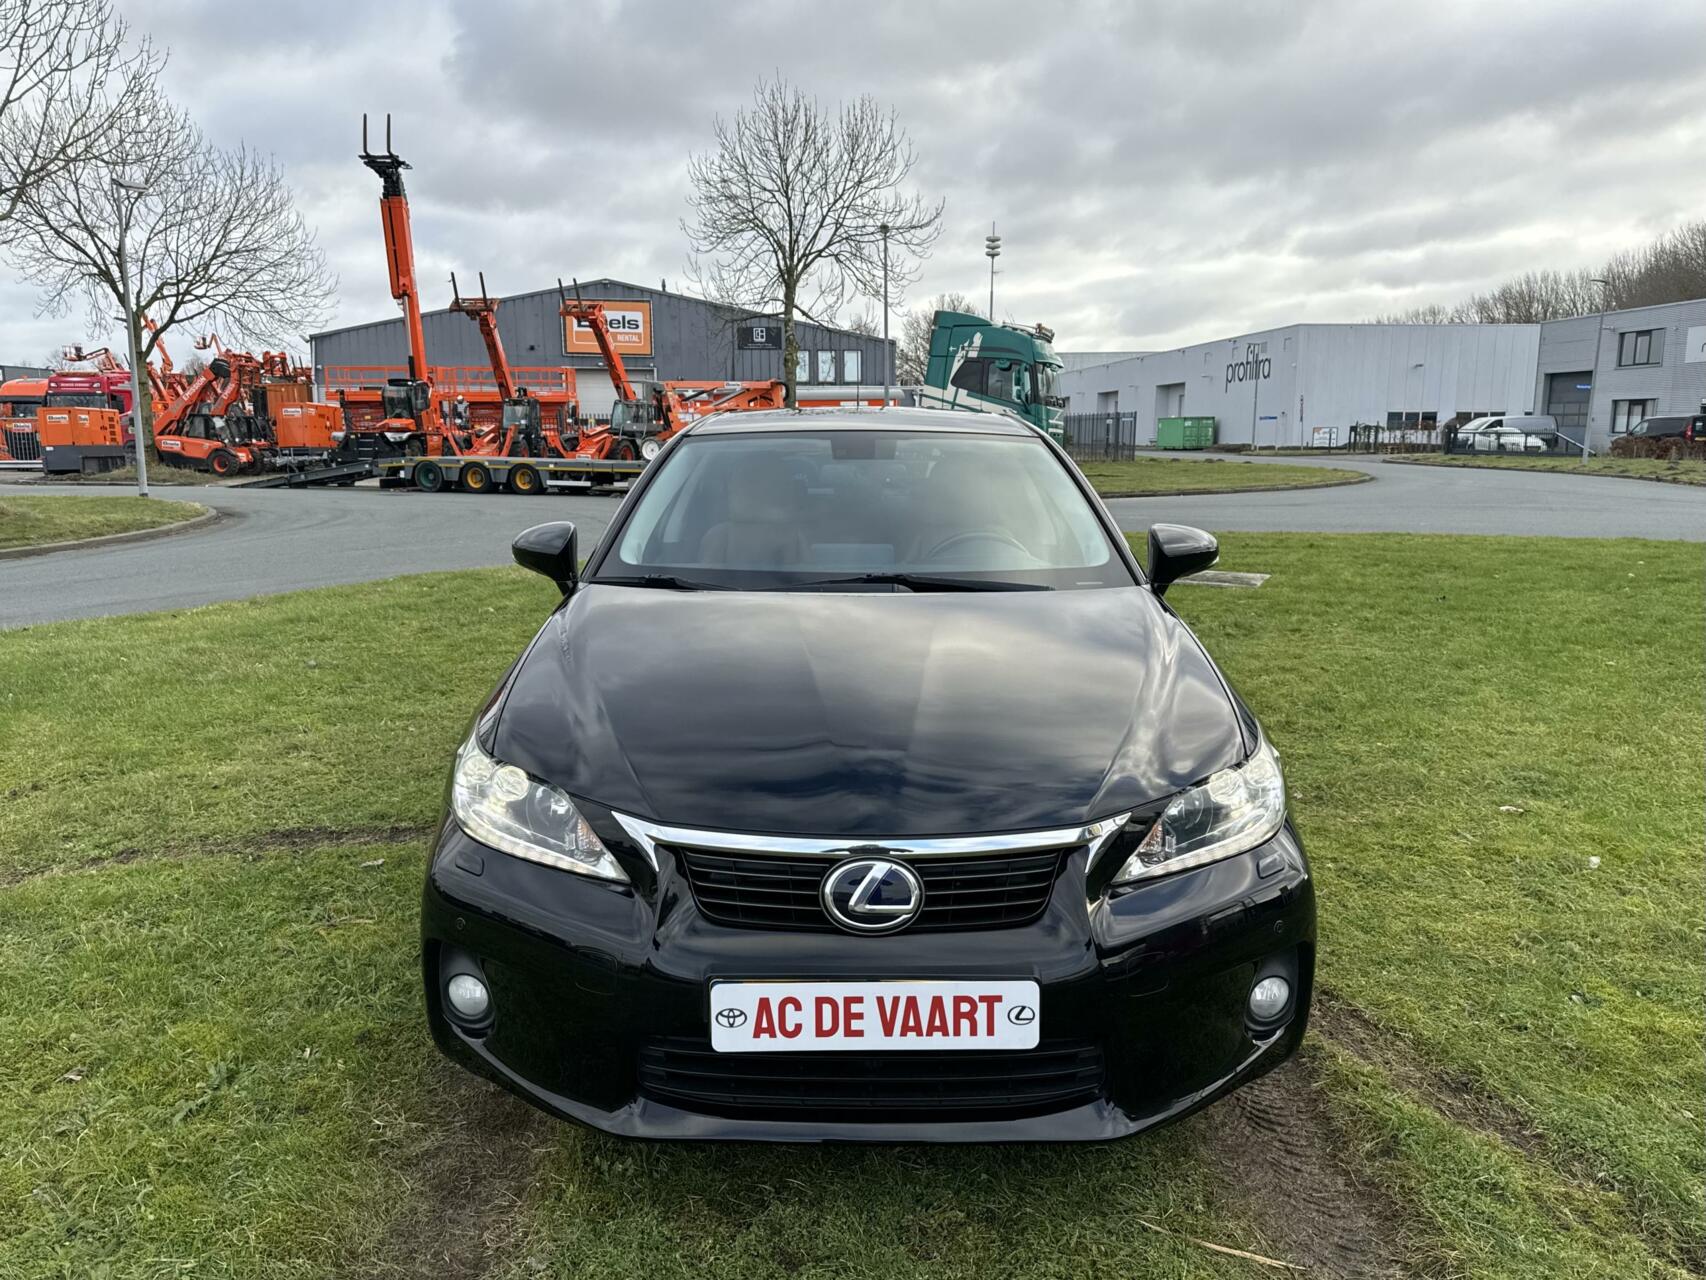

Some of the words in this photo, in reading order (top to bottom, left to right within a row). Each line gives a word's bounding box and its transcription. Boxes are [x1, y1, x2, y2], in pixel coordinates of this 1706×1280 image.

[617, 334, 640, 342] RENTAL
[1225, 343, 1271, 394] profiltra
[752, 996, 803, 1039] AC
[814, 996, 865, 1038] DE
[875, 995, 1003, 1038] VAART
